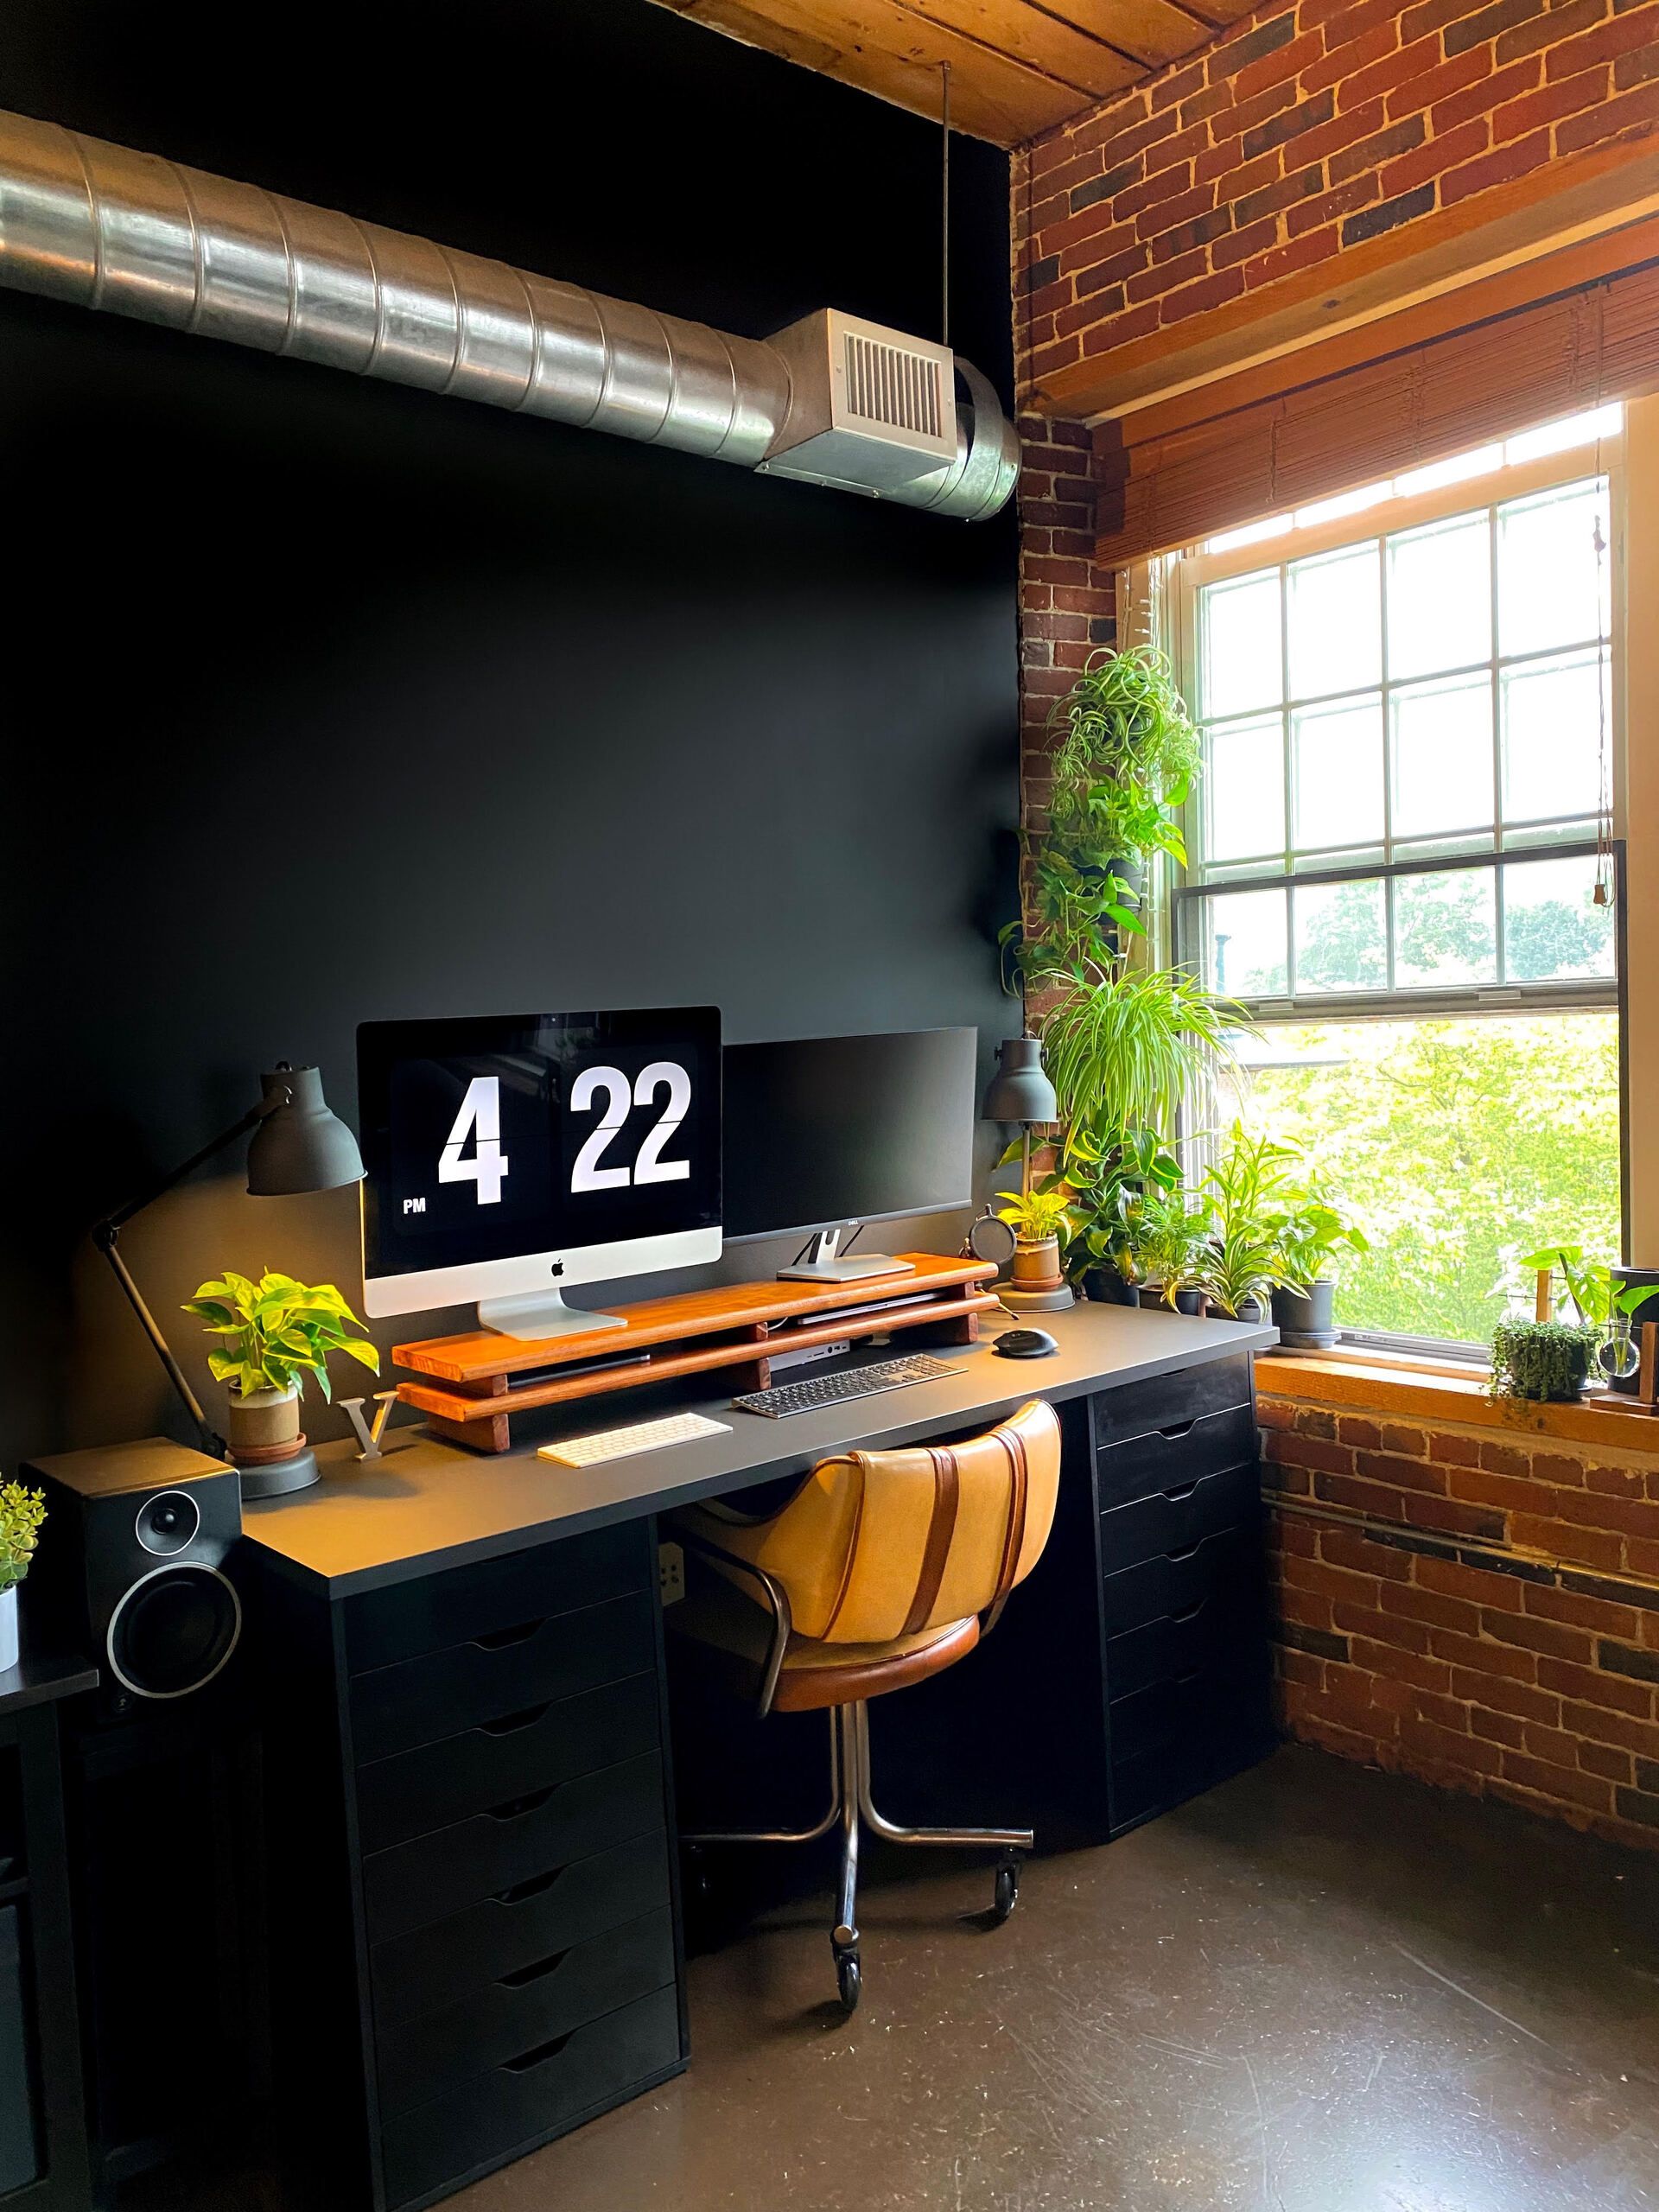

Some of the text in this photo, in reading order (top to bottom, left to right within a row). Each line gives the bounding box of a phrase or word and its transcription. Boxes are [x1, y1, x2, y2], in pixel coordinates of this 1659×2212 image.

[438, 1061, 690, 1205] 4 22
[403, 1197, 426, 1215] PM
[337, 1390, 400, 1461] V
